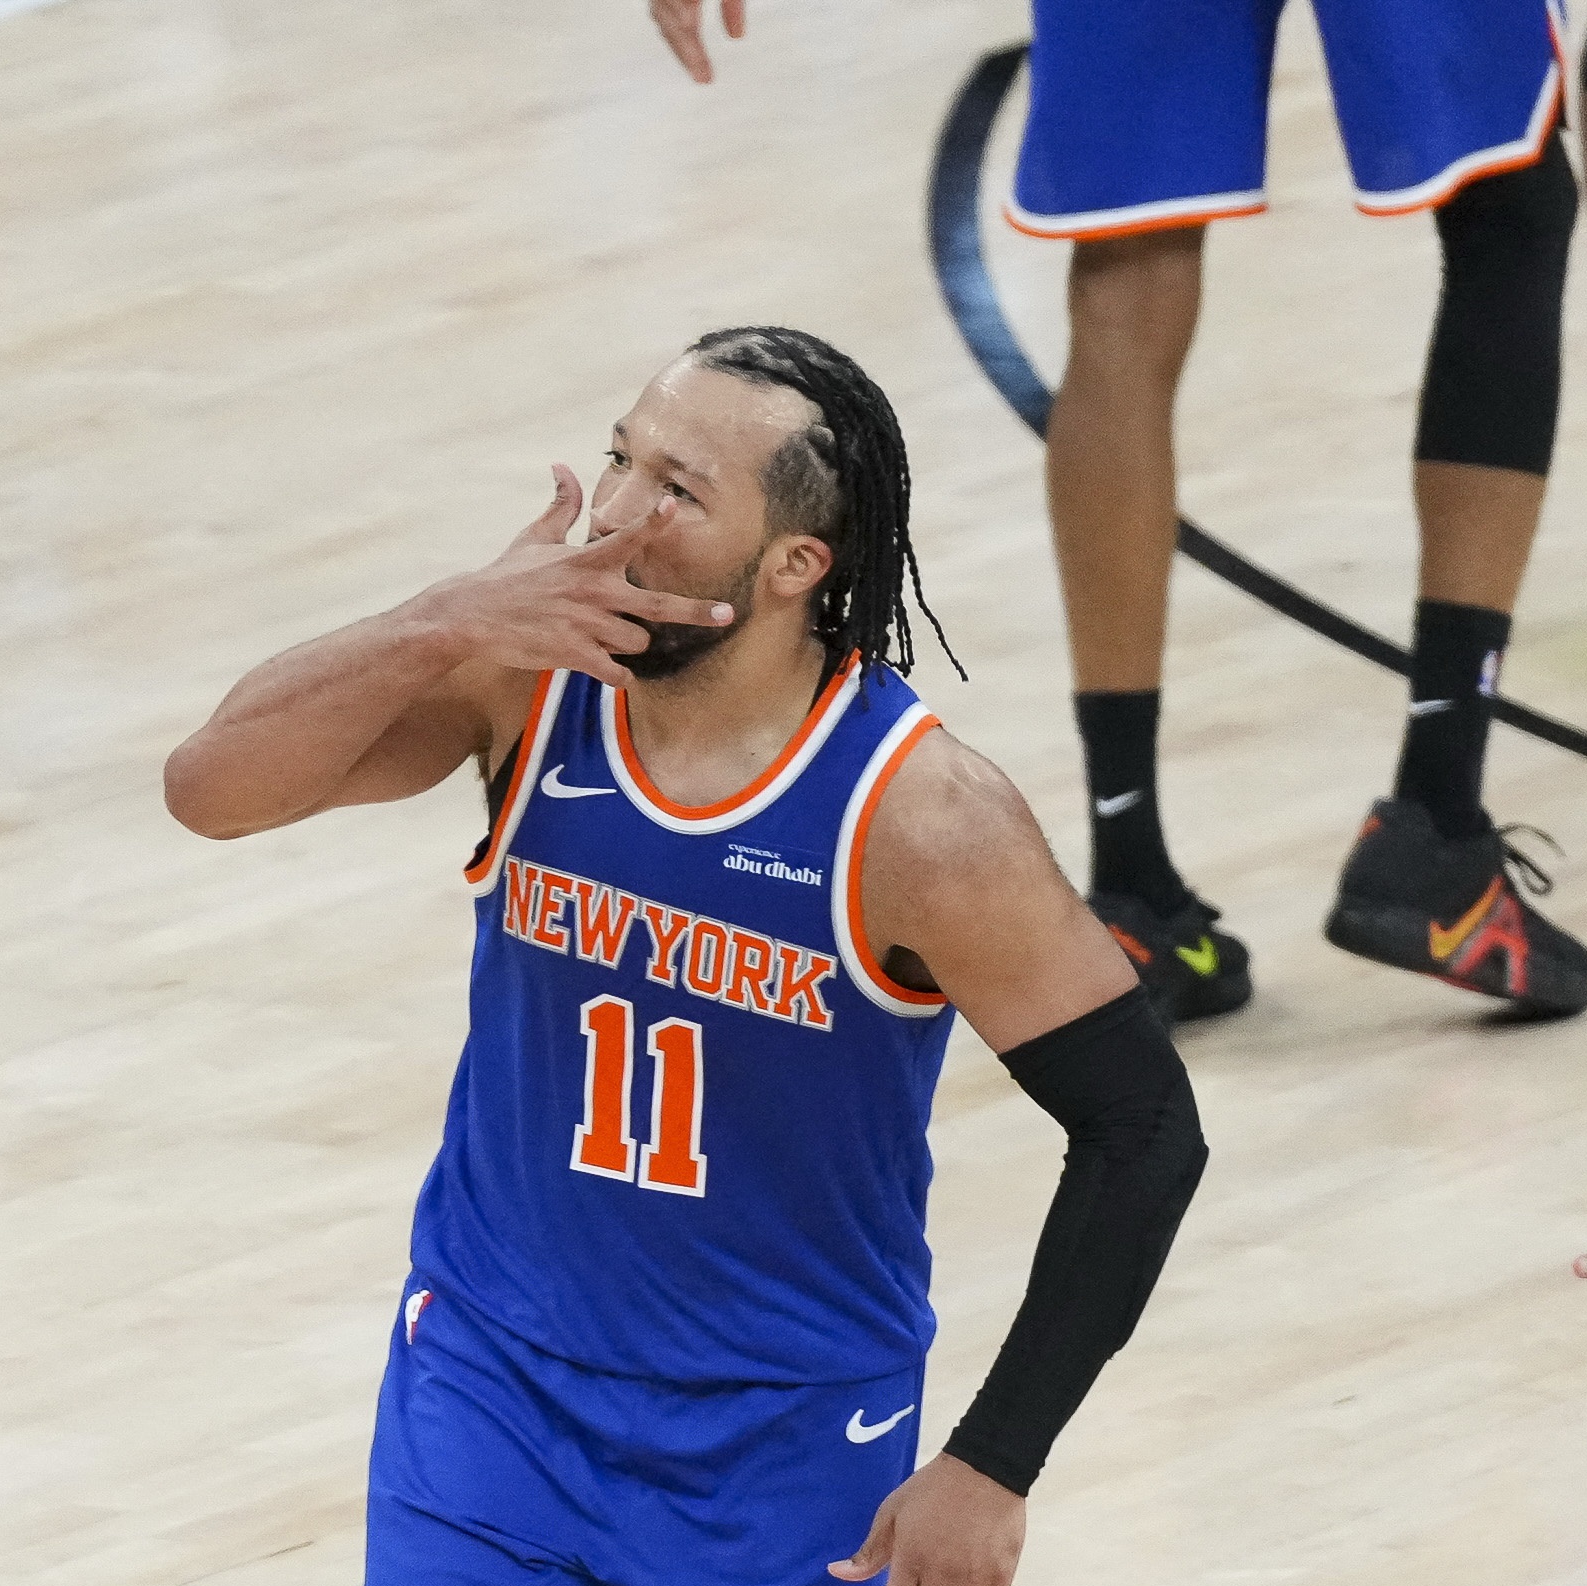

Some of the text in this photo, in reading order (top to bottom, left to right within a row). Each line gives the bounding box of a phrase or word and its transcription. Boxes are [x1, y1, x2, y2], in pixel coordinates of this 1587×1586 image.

[502, 856, 838, 1032] NEW YORK
[723, 854, 824, 887] abu dhabi
[569, 993, 708, 1198] 11
